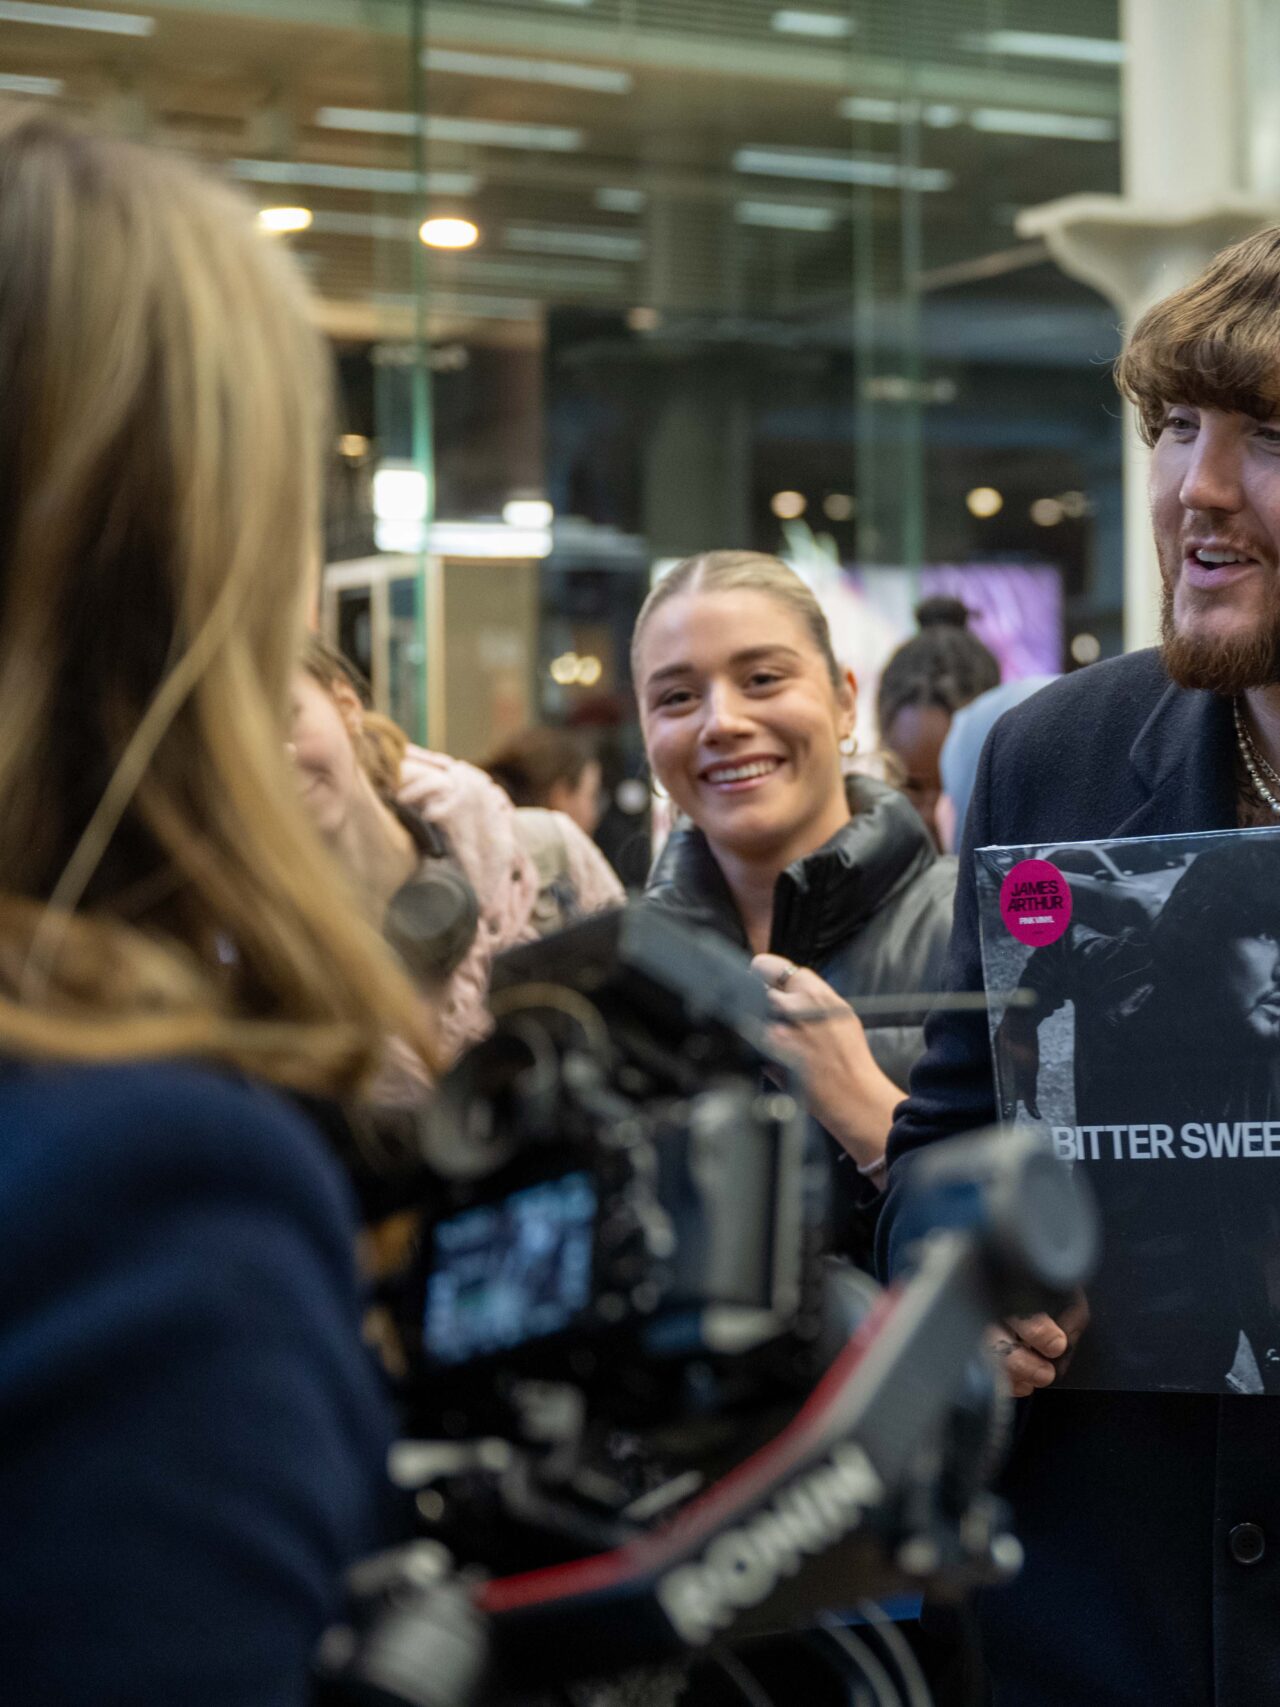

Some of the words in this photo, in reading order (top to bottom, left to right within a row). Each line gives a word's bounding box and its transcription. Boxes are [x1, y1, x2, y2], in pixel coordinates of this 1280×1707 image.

[1011, 880, 1059, 897] JAMES
[1007, 896, 1064, 912] ARTHUR
[1051, 1123, 1176, 1160] BITTER
